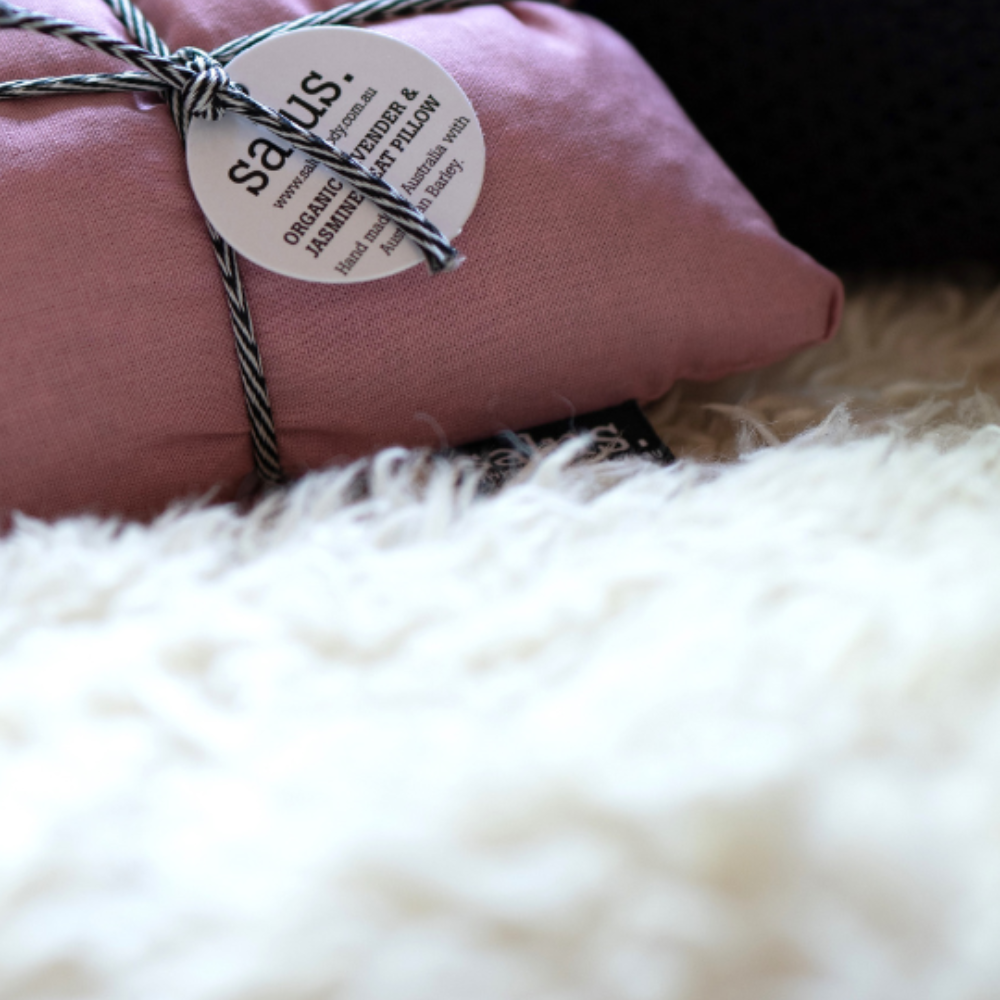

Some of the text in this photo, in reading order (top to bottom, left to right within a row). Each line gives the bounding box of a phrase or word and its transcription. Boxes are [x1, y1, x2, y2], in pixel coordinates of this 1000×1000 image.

[228, 70, 354, 196] saus.
[283, 87, 419, 247] ORGANIC VENDER &
[393, 94, 441, 152] PILLOW
[426, 158, 465, 192] Barley.
[335, 115, 470, 276] Hand mad Australia with
